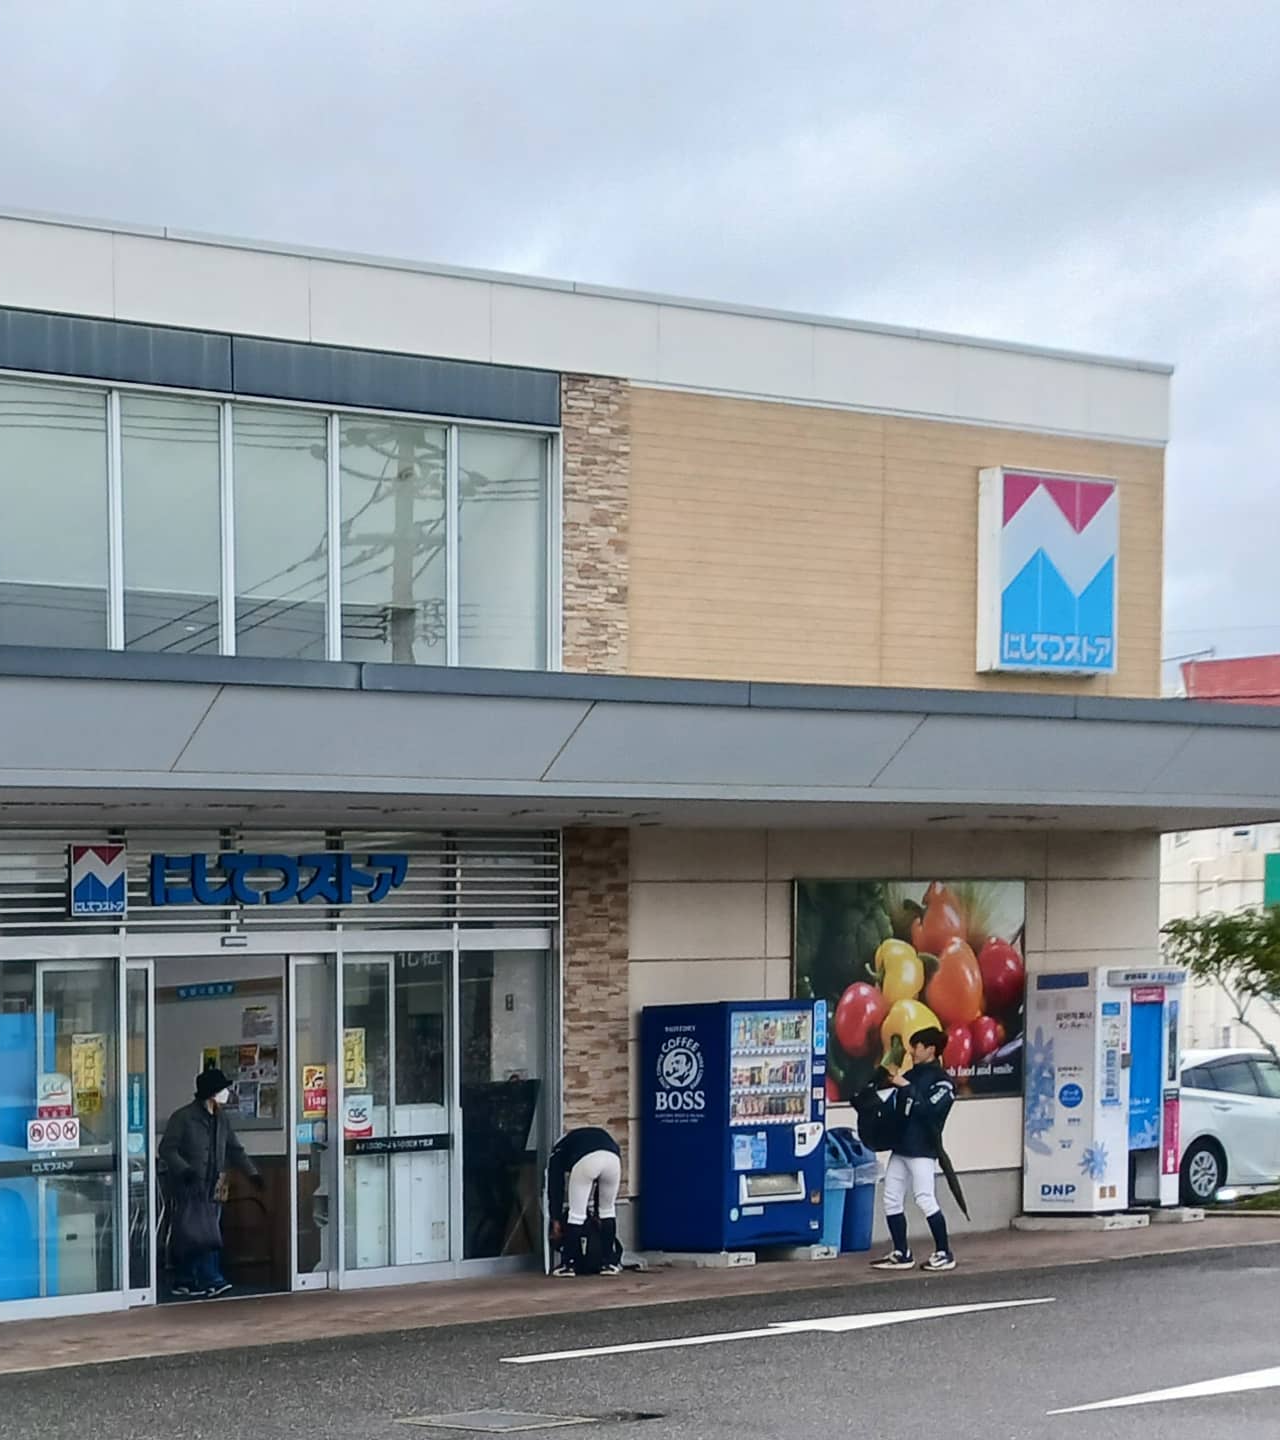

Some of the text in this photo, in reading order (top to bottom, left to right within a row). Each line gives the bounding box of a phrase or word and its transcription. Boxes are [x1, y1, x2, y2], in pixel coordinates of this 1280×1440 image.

[1003, 632, 1111, 663] にしてつストア
[150, 853, 408, 906] にしてつストア
[74, 901, 125, 913] にしてつストア
[661, 1036, 700, 1053] COFFEE
[655, 1090, 705, 1110] BOSS
[348, 1107, 368, 1118] CGC
[1041, 1184, 1076, 1196] DNP
